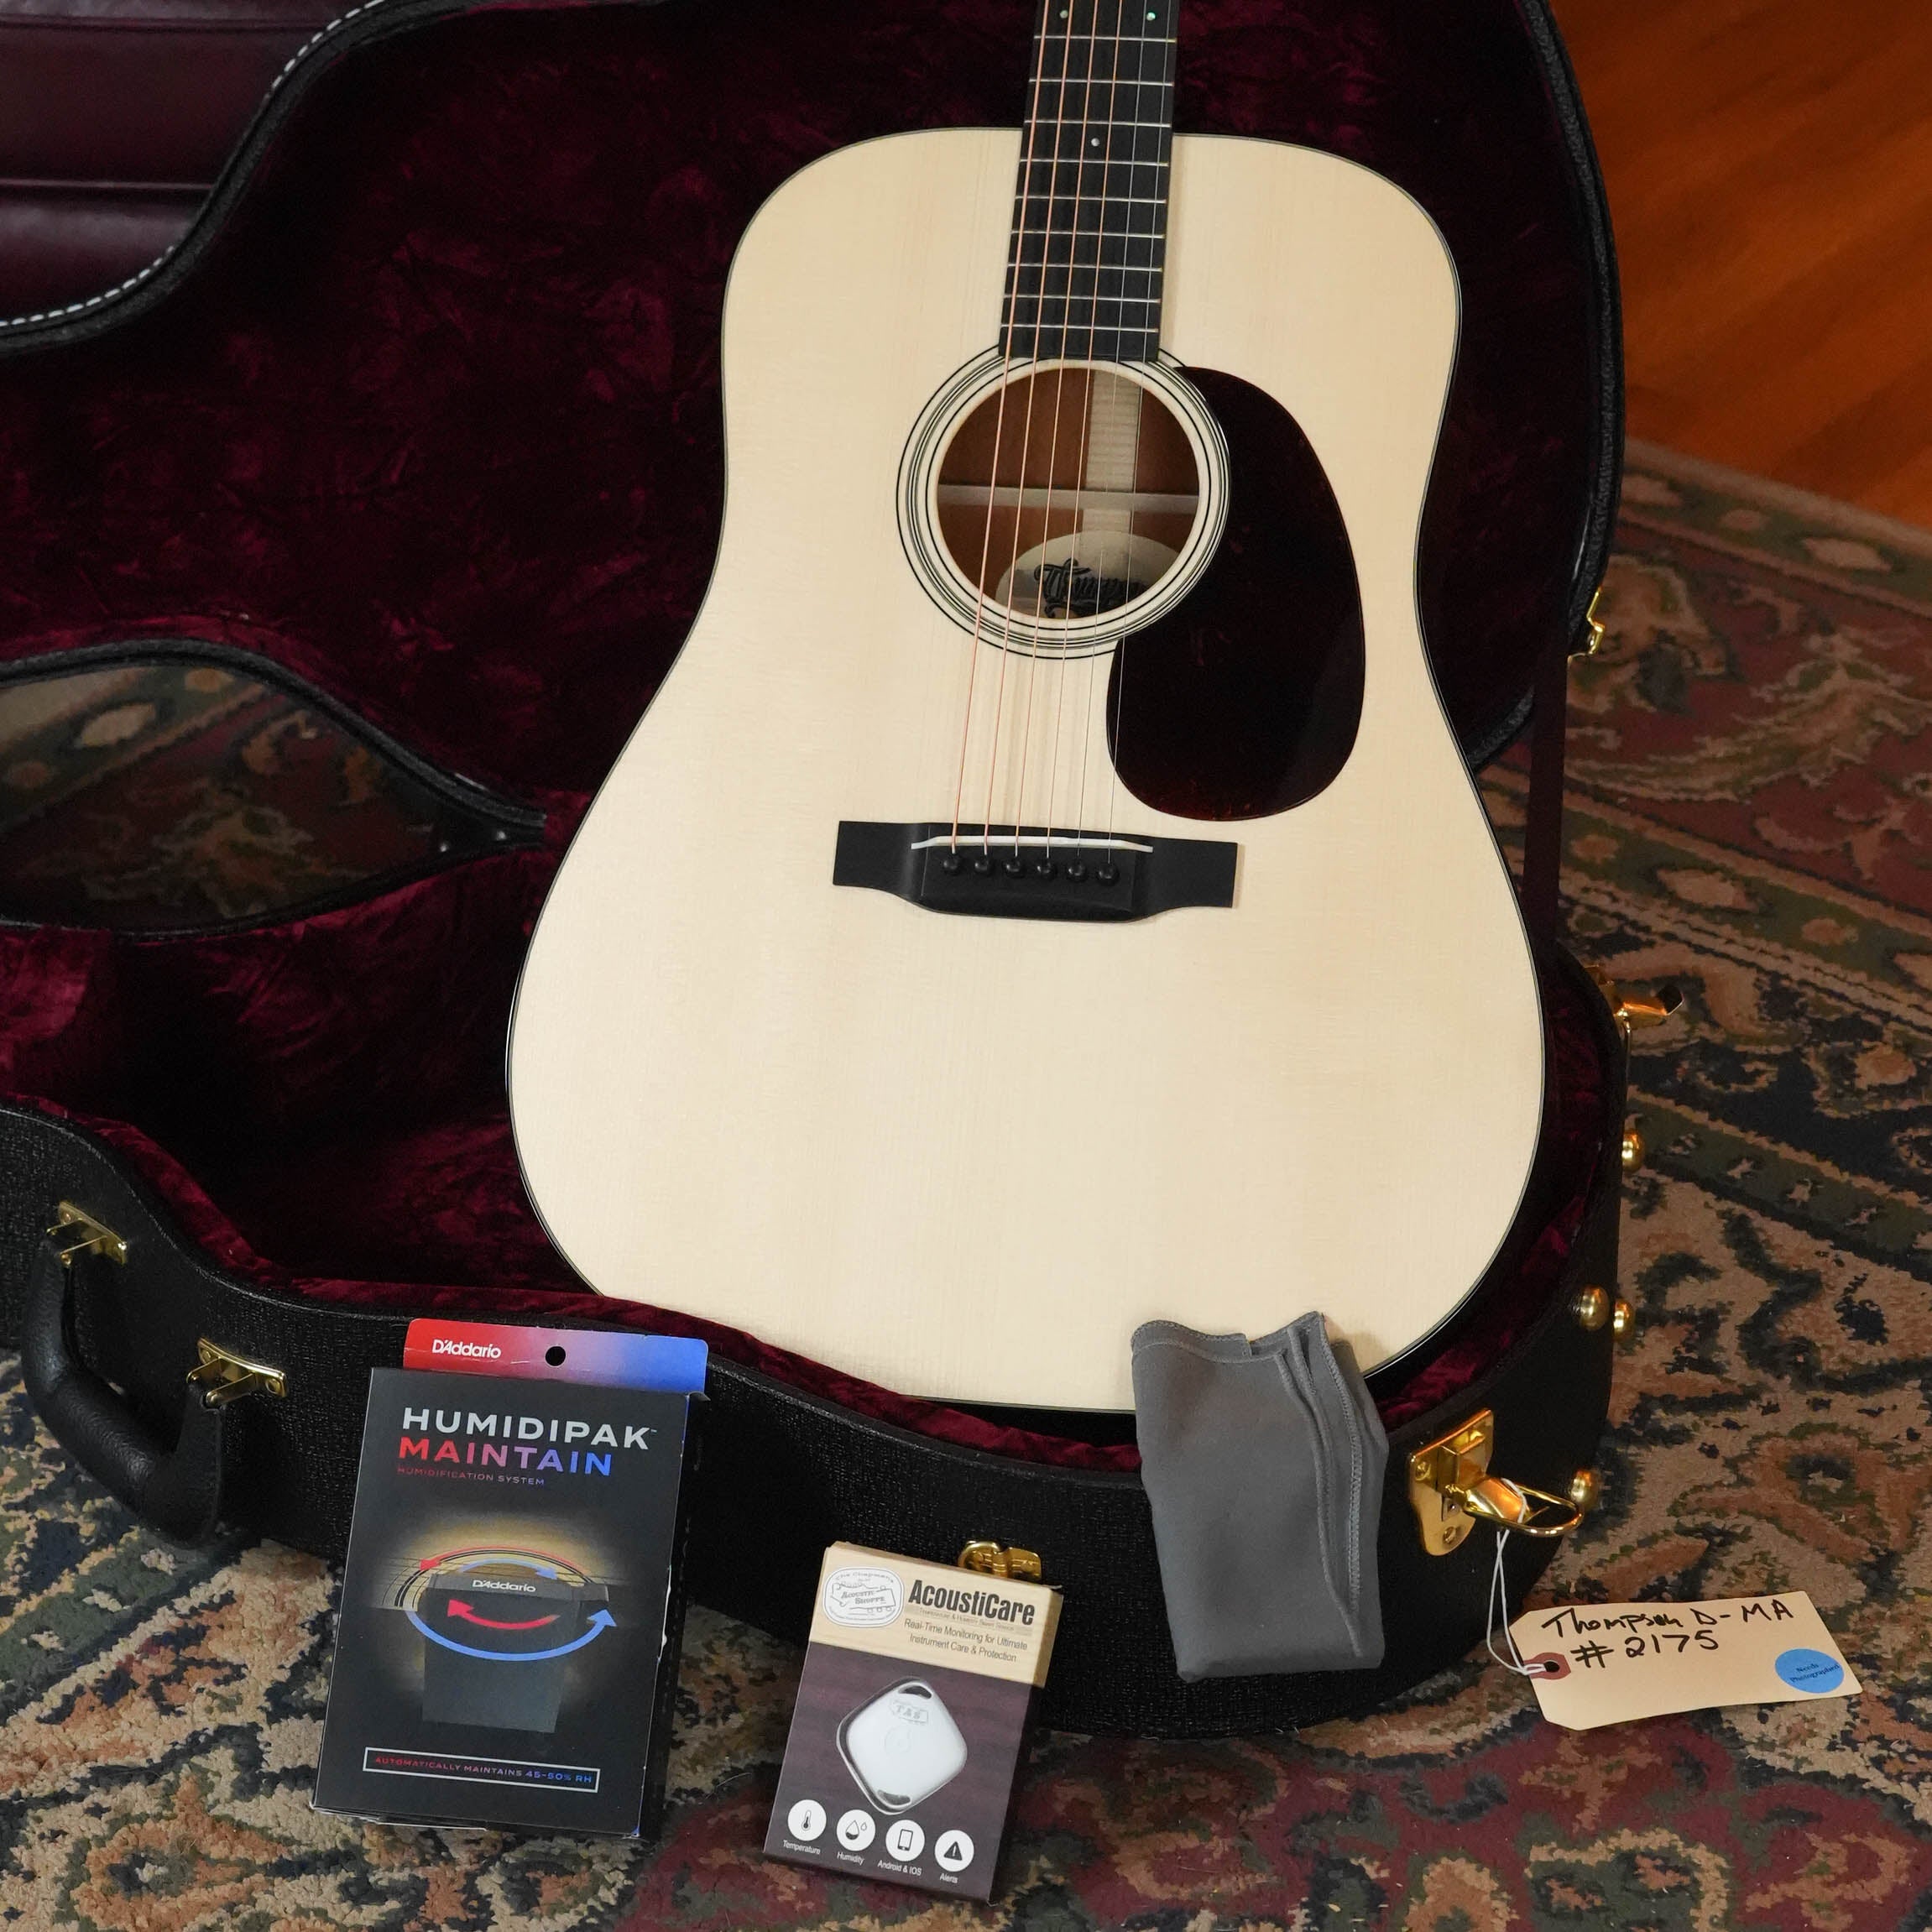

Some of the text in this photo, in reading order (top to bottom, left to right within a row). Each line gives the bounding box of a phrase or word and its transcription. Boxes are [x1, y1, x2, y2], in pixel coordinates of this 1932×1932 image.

[431, 1339, 501, 1360] D'Addario
[402, 1407, 651, 1450] HUMIDIPAK
[398, 1436, 613, 1476] MAINTAIN
[397, 1466, 545, 1485] HUMIDIFICATION SYSTEM
[472, 1580, 536, 1592] D'Addario
[908, 1580, 1035, 1626] AcoustiCare
[1542, 1607, 1684, 1637] Thompson
[904, 1618, 942, 1633] Real-Time
[943, 1626, 983, 1643] Monitoring
[985, 1634, 995, 1644] for
[997, 1636, 1027, 1650] Ultimate
[910, 1633, 1016, 1663] Instrument Care & Protection
[375, 1757, 460, 1771] AUTOMATICALLY
[463, 1765, 522, 1778] MAINTAINS
[575, 1774, 592, 1783] RH
[782, 1839, 821, 1855] Temperature
[837, 1851, 864, 1866] Humidity
[877, 1860, 902, 1872] Android
[902, 1864, 908, 1872] &
[939, 1872, 958, 1884] Alerts
